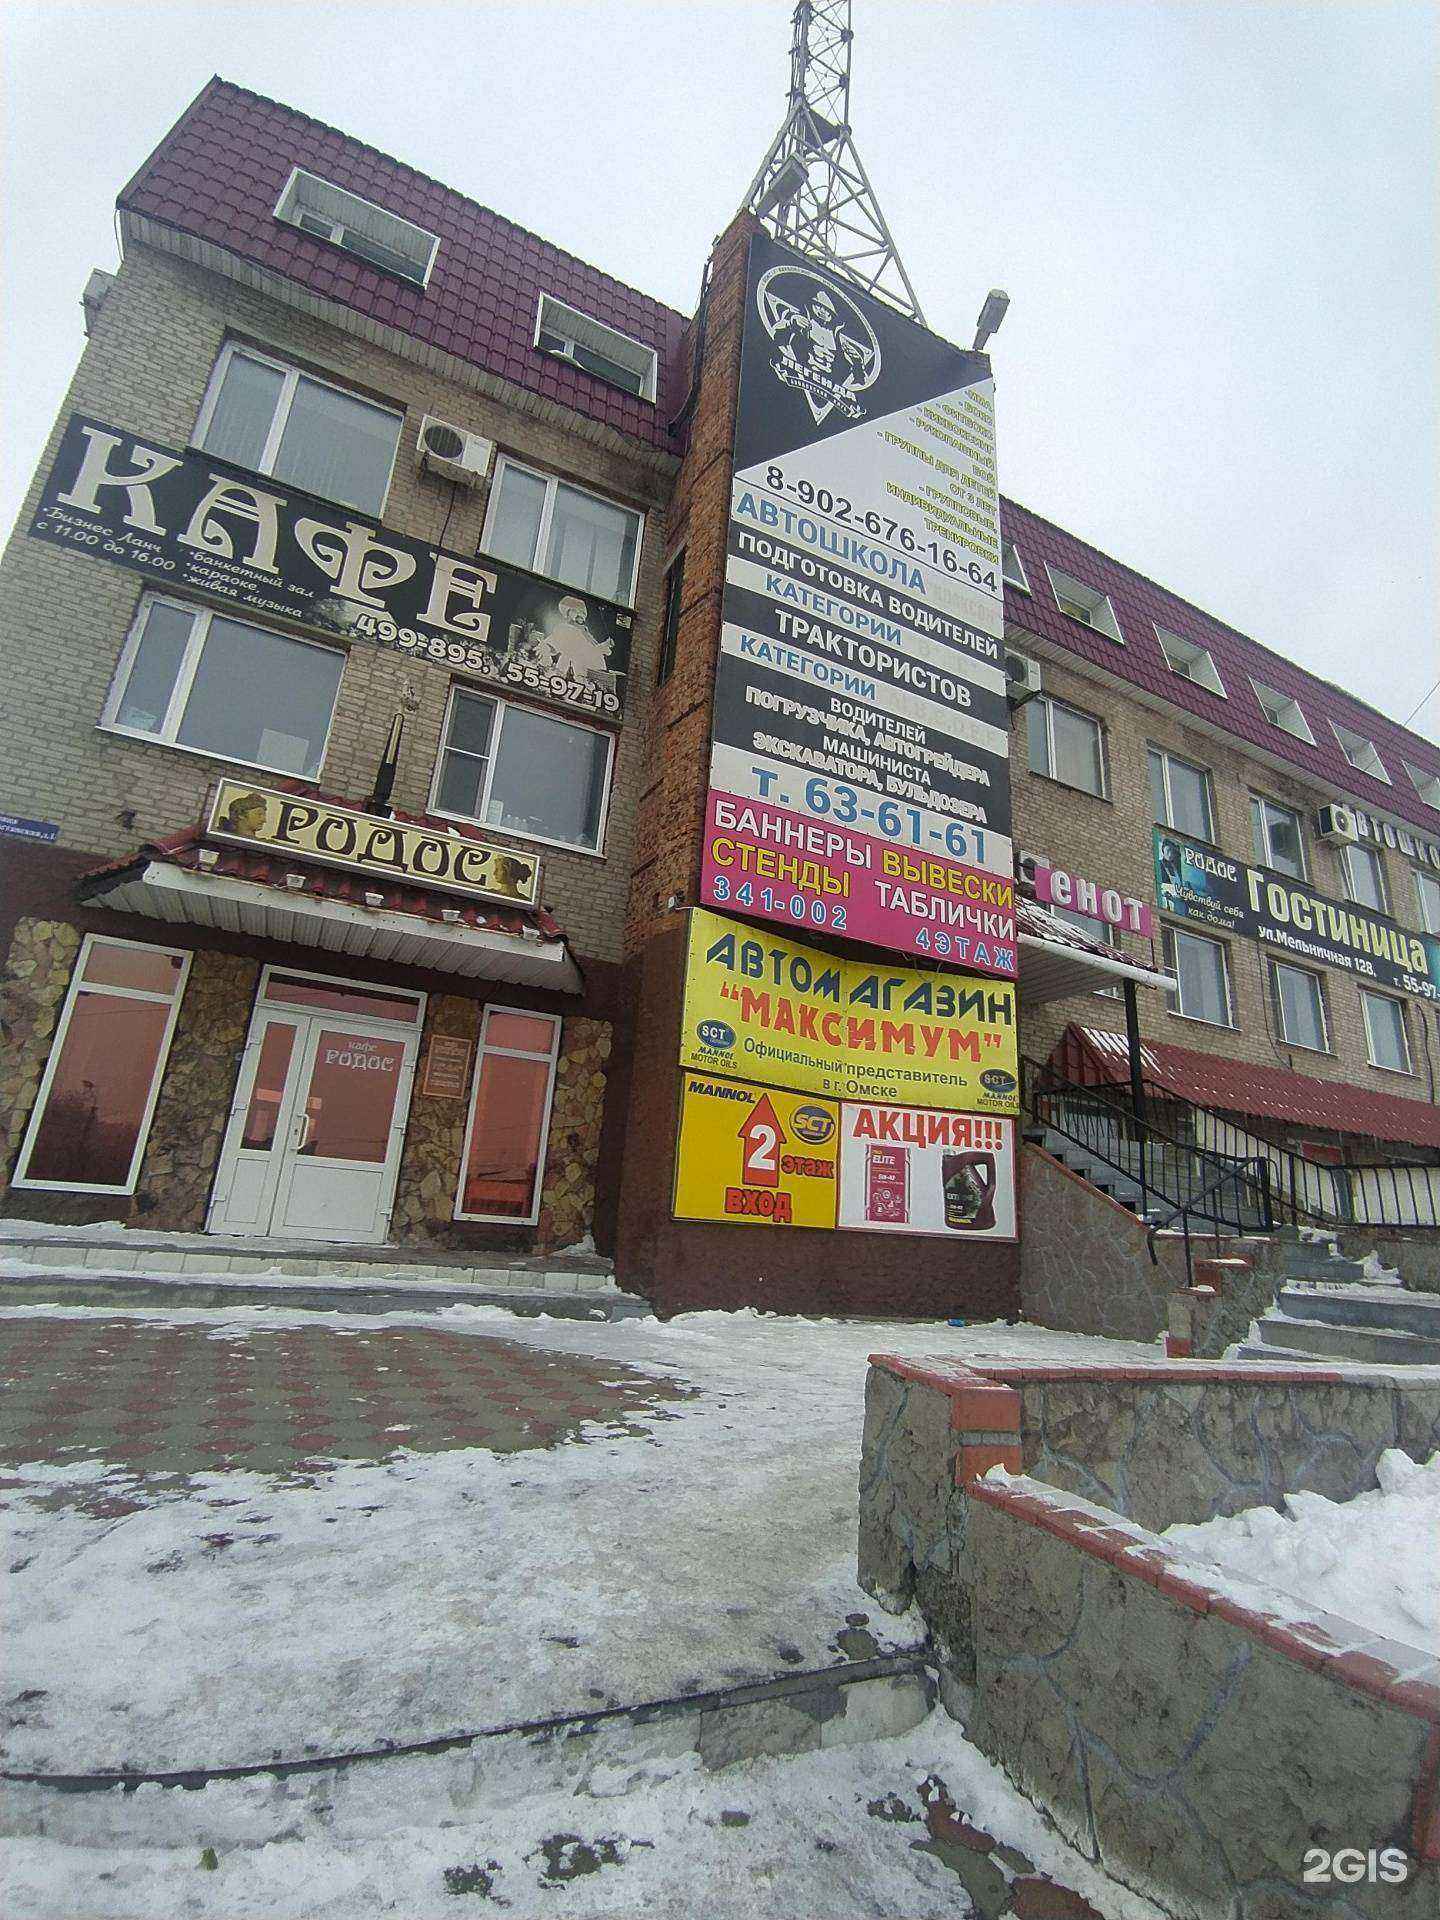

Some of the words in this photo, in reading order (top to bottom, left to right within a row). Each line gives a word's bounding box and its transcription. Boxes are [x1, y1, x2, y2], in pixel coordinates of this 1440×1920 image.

[961, 472, 997, 500] ДЕТЕЙ
[36, 520, 46, 530] с
[103, 540, 126, 556] до
[46, 507, 113, 537] Бизнес
[57, 426, 498, 642] КАФЕ
[766, 465, 998, 593] 8-902-676-16-64
[886, 480, 999, 549] ИНДИВИДУАЛЬНЫЕ
[736, 491, 927, 596] АВТОШКОЛА
[924, 515, 999, 565] ТРЕНИРОВКИ
[187, 574, 238, 598] живая
[243, 593, 304, 618] музыка
[193, 552, 284, 589] банкетный
[288, 582, 315, 598] зал
[737, 531, 884, 608] ПОДГОТОВКА
[888, 598, 999, 660] ВОДИТЕЛЕЙ
[765, 573, 902, 646] КАТЕГОРИИ
[740, 634, 876, 701] КАТЕГОРИИ
[775, 608, 971, 707] ТРАКТОРИСТОВ
[506, 662, 620, 713] 55-97-19
[745, 685, 870, 746] ПОГРУЗЧИКА,
[873, 731, 990, 787] АВТОГРЕЙДЕРА
[830, 697, 926, 746] ВОДИТЕЛЕЙ
[753, 731, 884, 792] ЭКСКАВАТОРА,
[885, 775, 988, 824] БУЛЬДОЗЕРА
[822, 736, 931, 786] МАШИНИСТА
[272, 799, 494, 885] РОДОС
[805, 777, 985, 864] 63-61-61
[714, 800, 872, 869] БАННЕРЫ
[882, 848, 1012, 909] ВЫВЕСКИ
[1184, 848, 1237, 882] РОДОС
[711, 837, 851, 898] СТЕНДЫ
[874, 880, 1014, 942] ТАБЛИЧКИ
[713, 876, 848, 931] 341-002
[1050, 870, 1143, 931] енот
[1176, 886, 1222, 912] Чувствуй
[1224, 905, 1244, 919] себя
[1188, 907, 1206, 921] как
[1207, 911, 1235, 929] дома!
[706, 932, 1013, 1027] АВТОМАГАЗИН
[348, 1041, 378, 1053] кафе
[698, 1046, 735, 1059] MANNOL
[701, 1025, 726, 1040] SCT
[690, 1052, 719, 1065] MOTOR
[744, 1037, 843, 1075] Официальный
[845, 1060, 968, 1087] представитель
[984, 1073, 1006, 1086] SCT
[688, 1081, 756, 1104] MANNOL
[822, 1079, 831, 1089] в
[833, 1082, 842, 1093] г.
[845, 1079, 898, 1098] Омске
[977, 1098, 1003, 1107] MOTOR
[748, 1124, 776, 1170] 2
[852, 1108, 1003, 1151] АКЦИЯ!!!
[781, 1155, 834, 1179] этаж
[725, 1187, 792, 1223] ВХОД
